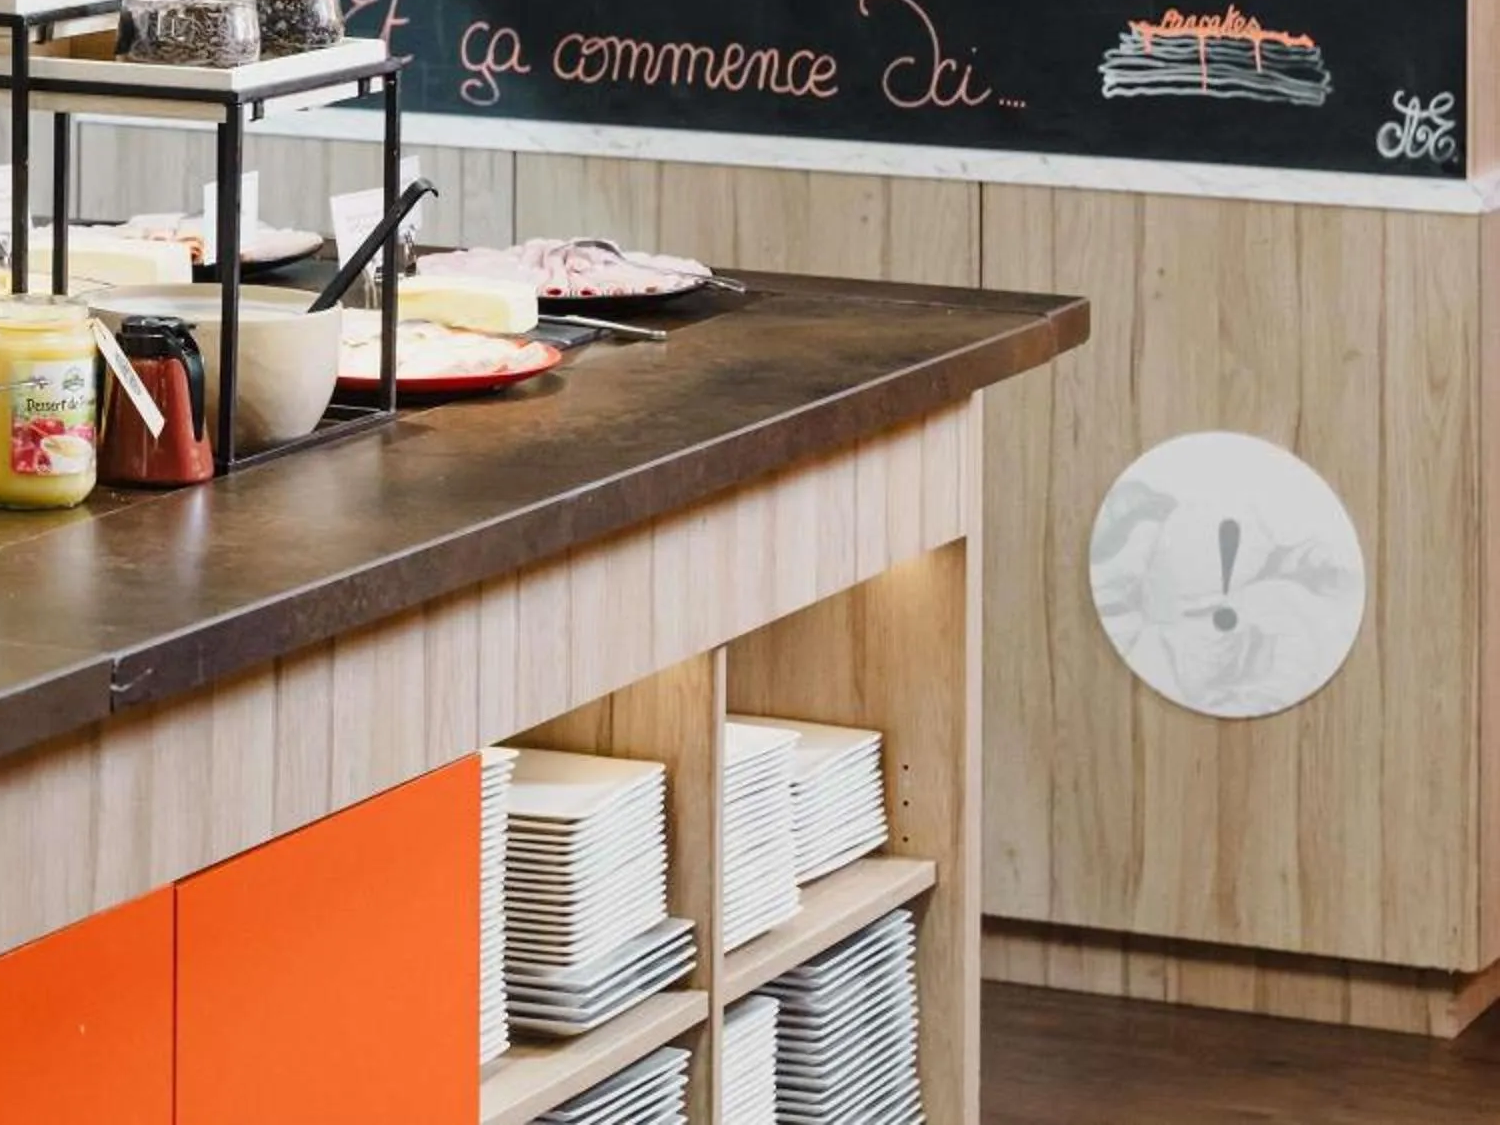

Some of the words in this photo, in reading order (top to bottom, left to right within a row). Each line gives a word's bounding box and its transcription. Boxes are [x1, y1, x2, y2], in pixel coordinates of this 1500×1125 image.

[460, 21, 532, 107] ça
[553, 33, 839, 98] commence
[25, 397, 67, 413] Dessert
